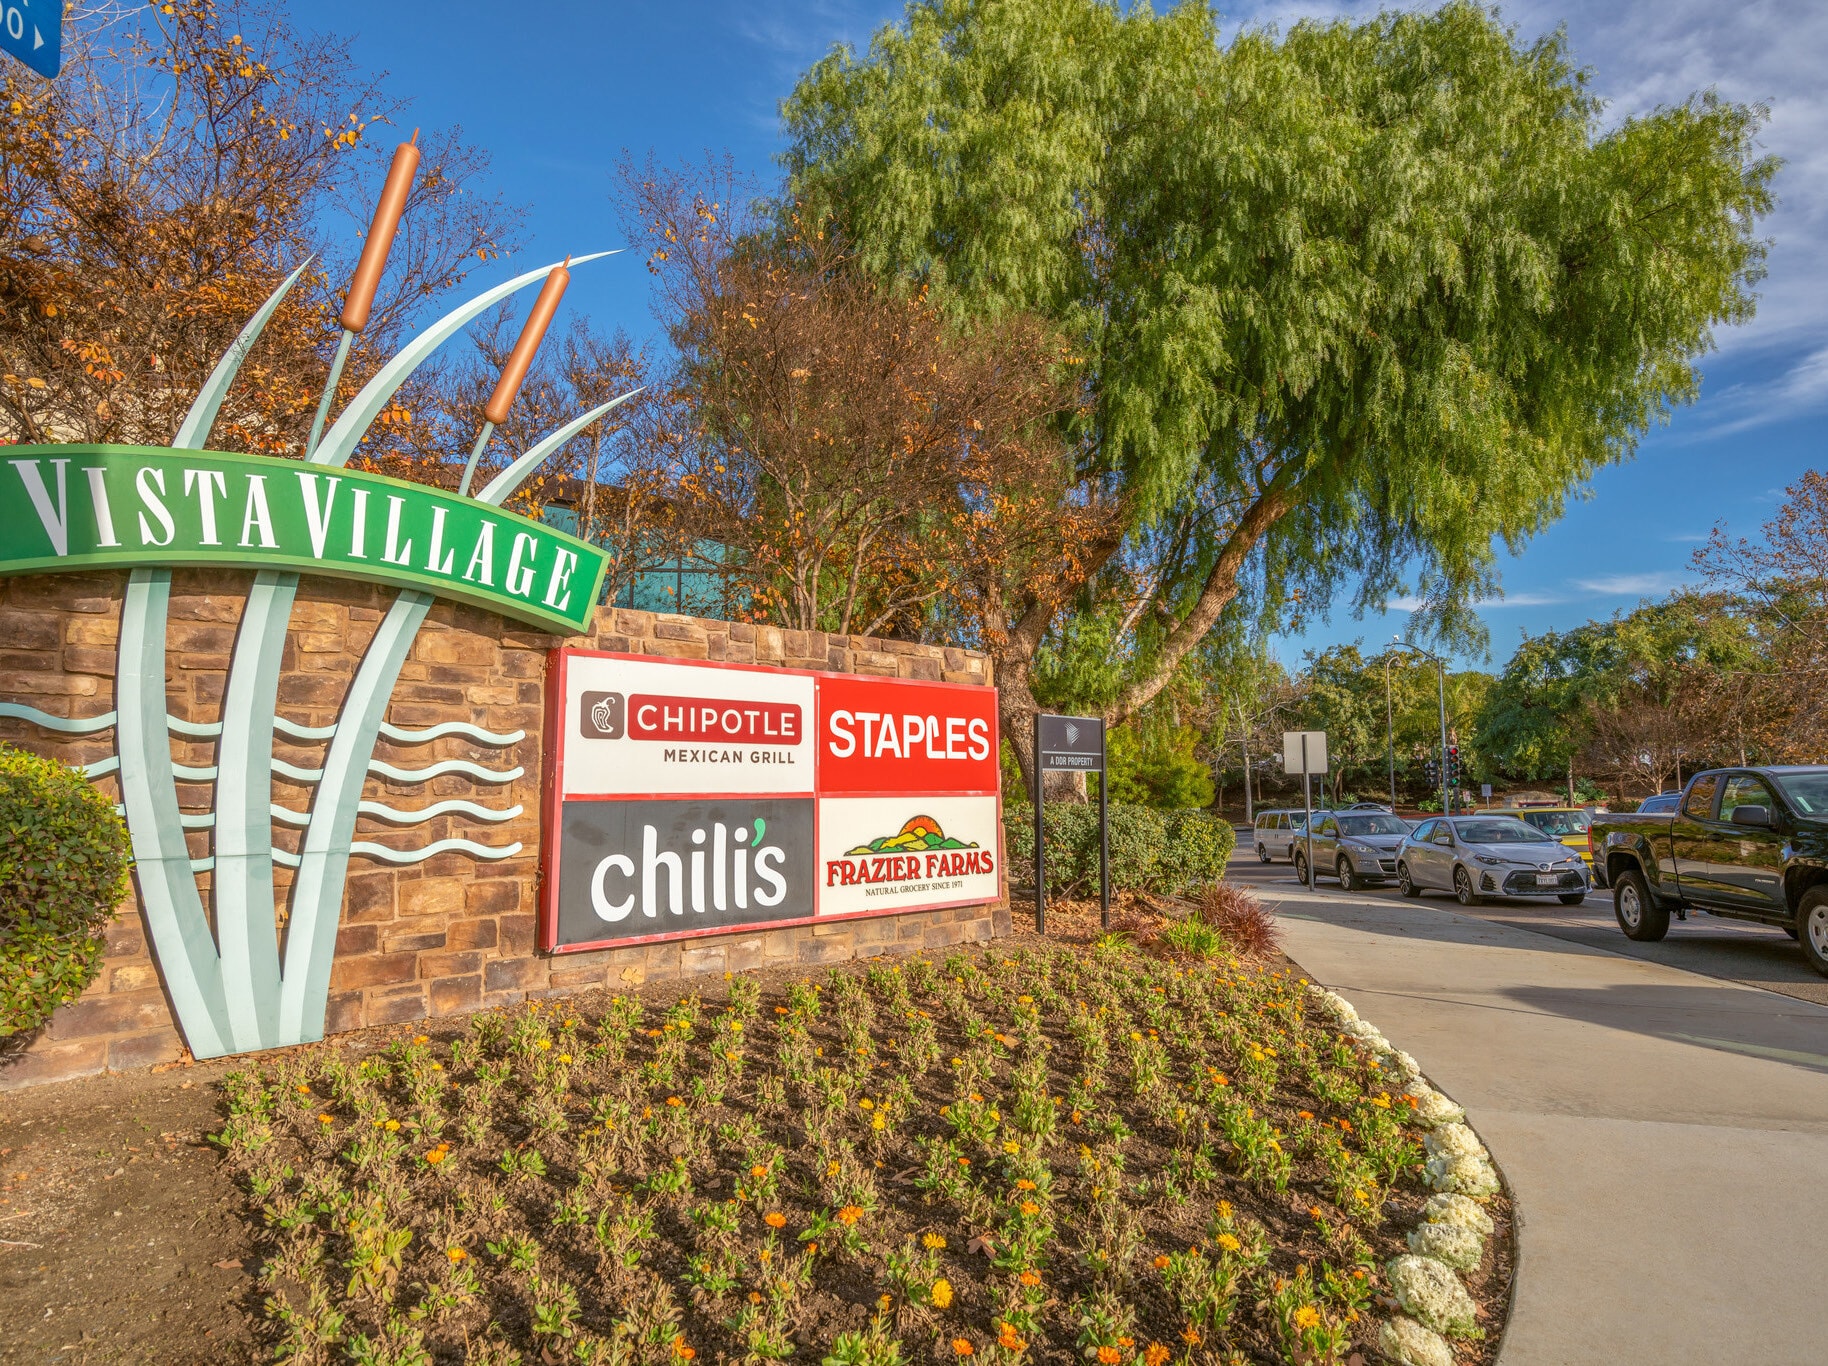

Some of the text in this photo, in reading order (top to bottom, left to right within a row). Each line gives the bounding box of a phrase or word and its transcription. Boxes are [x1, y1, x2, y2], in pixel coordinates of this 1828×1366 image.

[8, 458, 578, 612] VISTA VILLAGE
[636, 704, 796, 737] CHIPOTLE
[829, 709, 990, 761] STAPLES
[664, 749, 795, 765] MEXICAN GRILL
[1050, 756, 1054, 765] A
[1068, 756, 1093, 766] PROPERTY
[591, 818, 788, 922] chili's
[827, 850, 994, 887] FRAZIER FARMS
[865, 880, 964, 896] NATURAL GROCERY SINCE 1971
